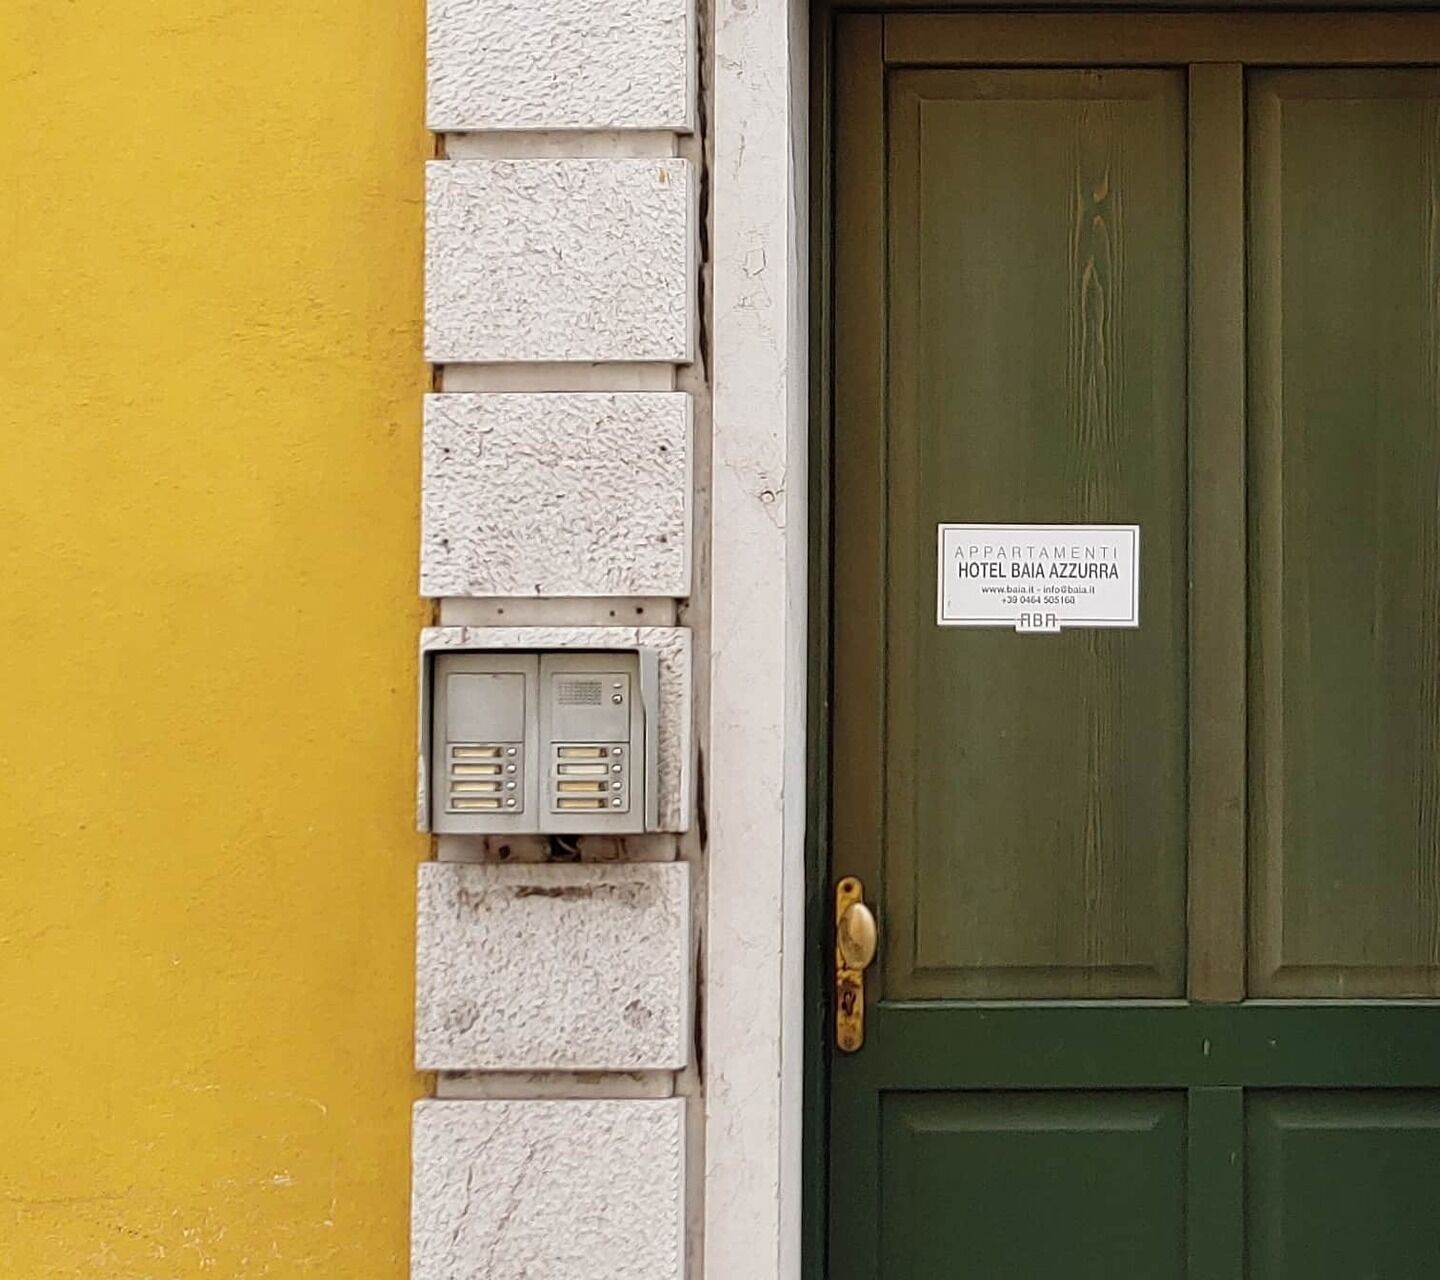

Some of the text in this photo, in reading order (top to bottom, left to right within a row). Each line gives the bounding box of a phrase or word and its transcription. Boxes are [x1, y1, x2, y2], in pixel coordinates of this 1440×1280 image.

[954, 546, 1118, 559] APPARTAMENTI
[958, 562, 1119, 579] HOTEL BAIA AZZURRA
[981, 585, 1034, 595] www.baia.it
[1043, 585, 1095, 595] info@baia.it
[1002, 596, 1018, 605] +39
[1020, 596, 1041, 605] 0464
